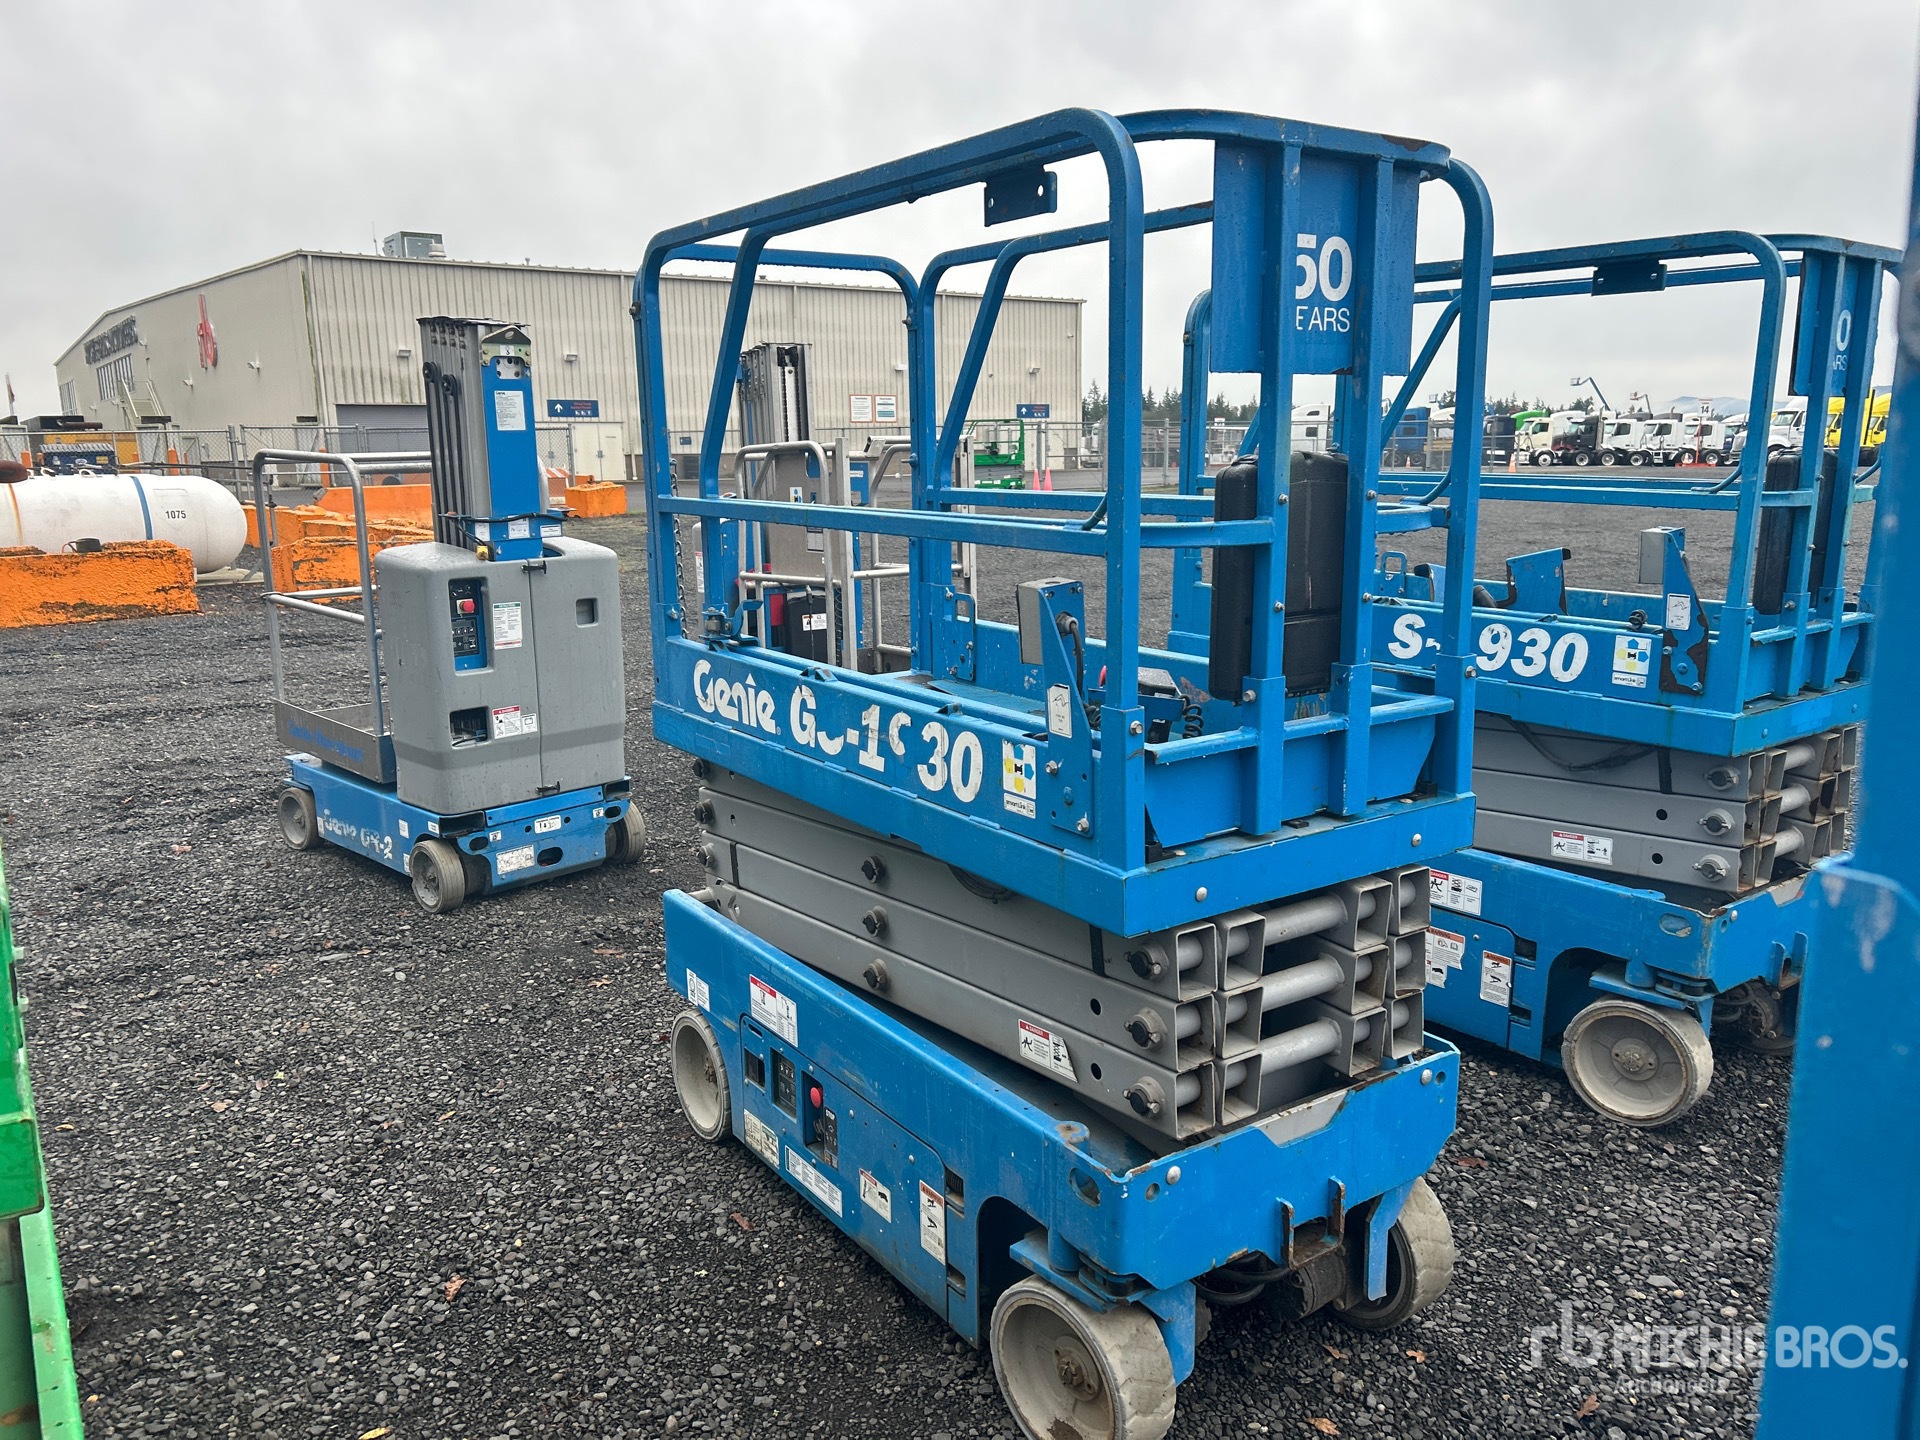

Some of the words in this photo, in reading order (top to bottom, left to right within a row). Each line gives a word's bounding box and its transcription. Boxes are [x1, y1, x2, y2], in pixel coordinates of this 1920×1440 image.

[1295, 233, 1353, 302] 50
[1701, 405, 1710, 414] 14
[165, 510, 187, 520] 1075
[1388, 613, 1589, 683] S-930
[693, 659, 776, 735] Genie
